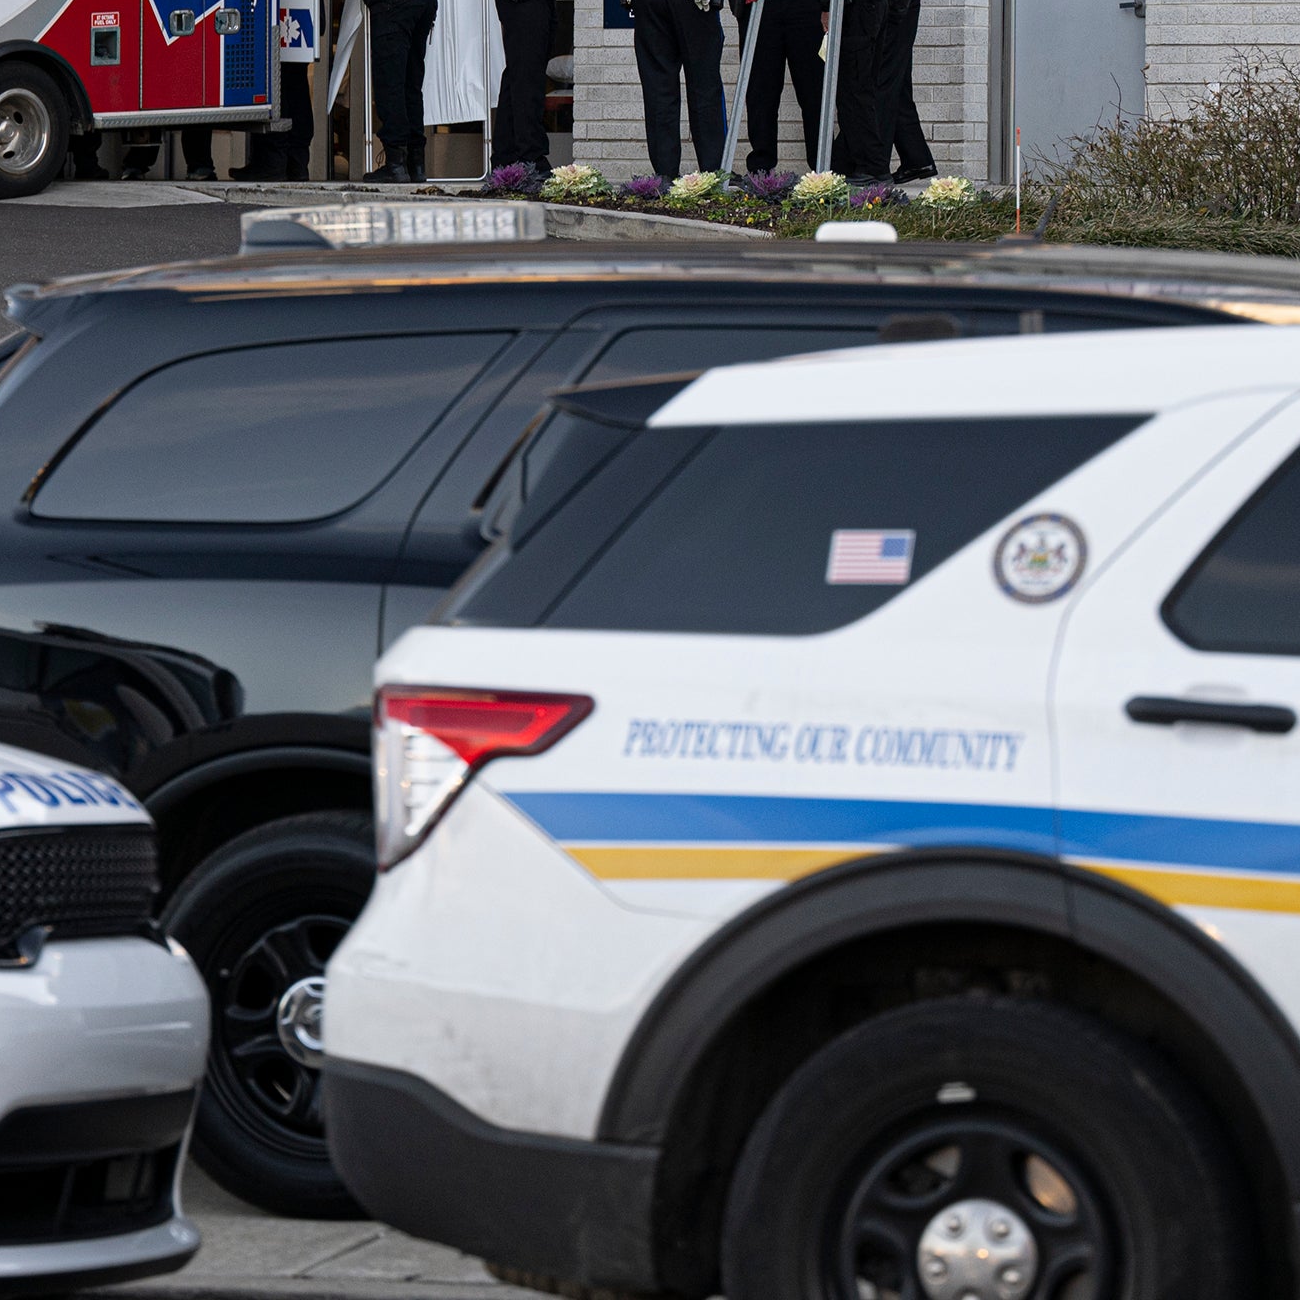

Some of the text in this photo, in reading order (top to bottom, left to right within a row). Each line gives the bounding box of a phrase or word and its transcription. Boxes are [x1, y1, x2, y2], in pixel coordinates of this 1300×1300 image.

[622, 718, 1026, 772] PROTECTING OUR COMMUNITY
